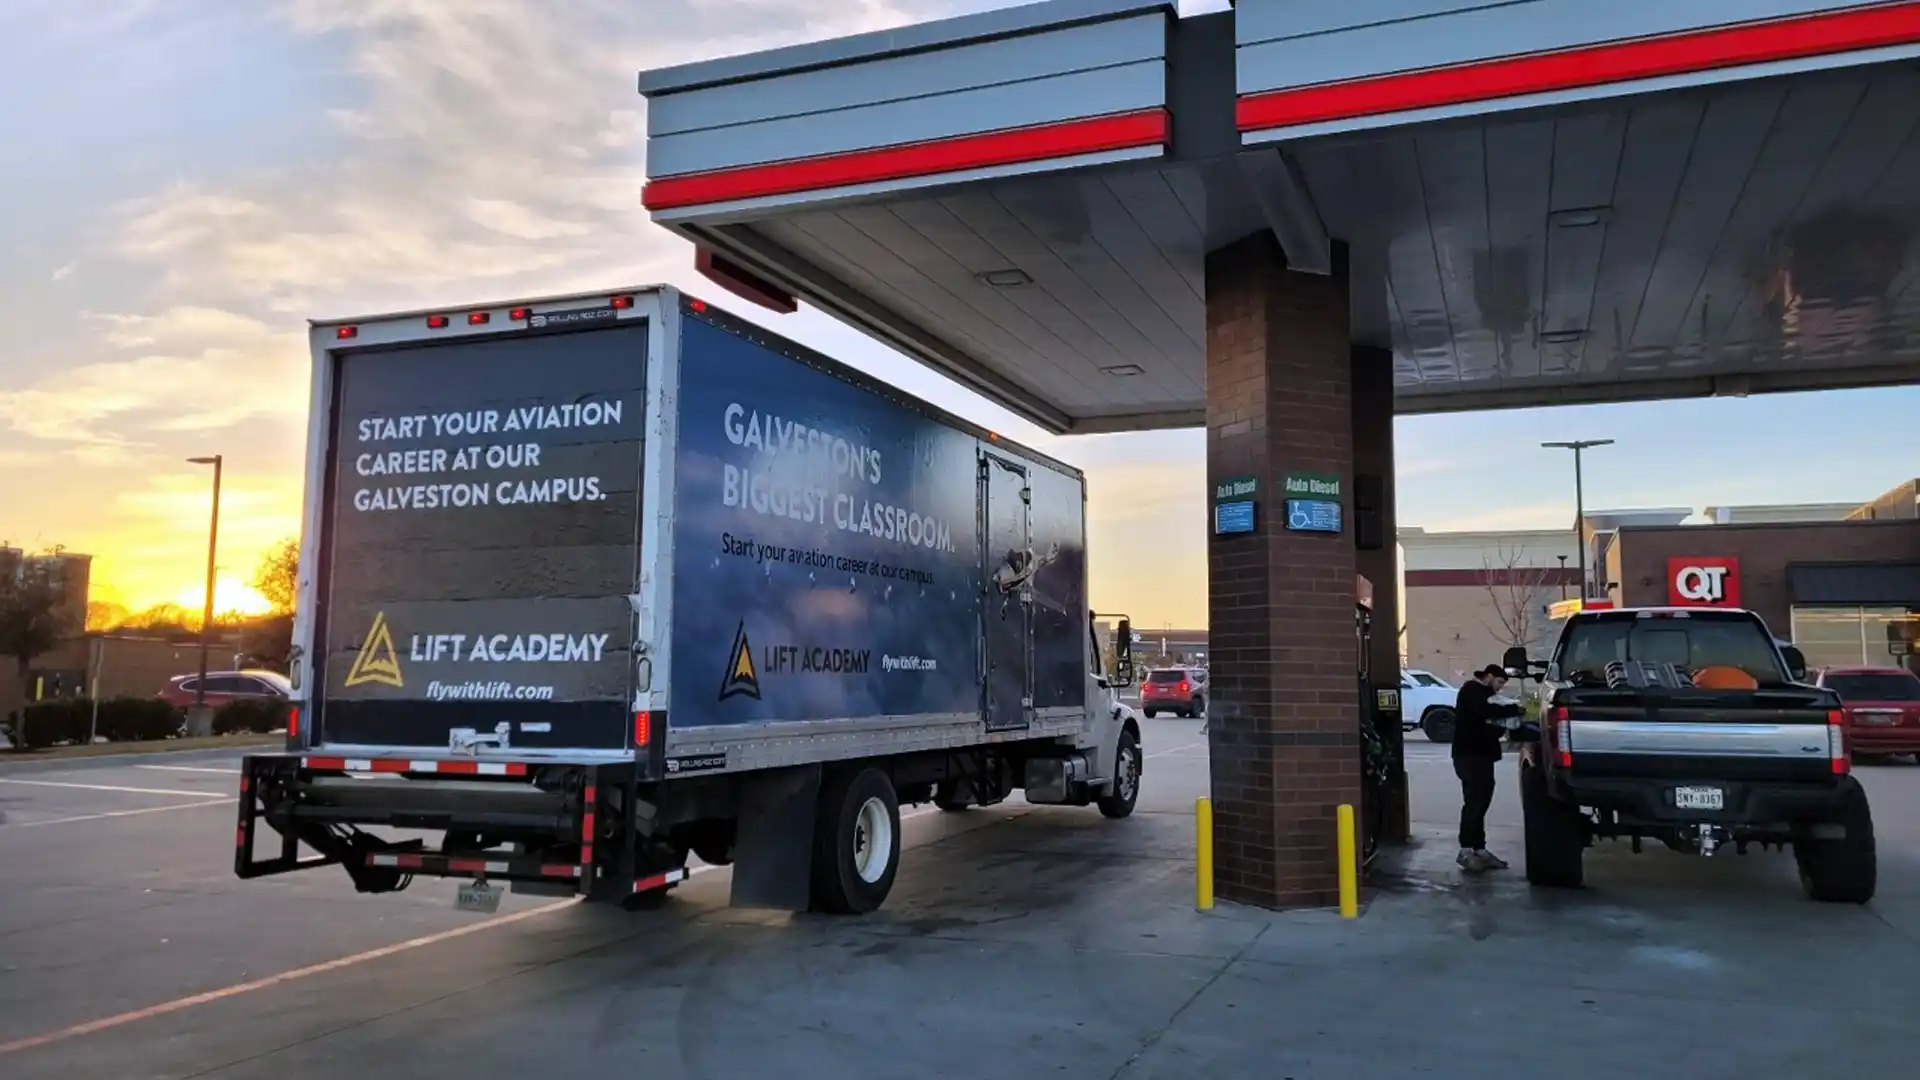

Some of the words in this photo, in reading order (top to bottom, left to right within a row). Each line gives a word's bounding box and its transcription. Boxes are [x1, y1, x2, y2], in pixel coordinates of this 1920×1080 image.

[358, 415, 428, 441] START
[432, 410, 498, 436] YOUR
[503, 400, 622, 432] AVIATION
[355, 448, 447, 476] CAREER
[452, 447, 483, 471] AT
[486, 443, 540, 468] OUR
[724, 403, 881, 485] GALVESTON'S
[354, 482, 489, 511] GALVESTON
[496, 476, 606, 505] CAMPUS.
[1216, 484, 1232, 499] Auto
[1233, 478, 1255, 496] Diesel
[1286, 477, 1308, 492] Auto
[1310, 479, 1340, 495] Diesel
[723, 463, 829, 525] BIGGEST
[833, 493, 956, 553] CLASSROOM.
[722, 532, 754, 558] Start
[757, 543, 786, 564] your
[788, 547, 834, 569] aviation
[835, 555, 867, 574] career
[869, 561, 879, 576] at
[881, 565, 899, 578] our
[1676, 566, 1727, 602] QT
[410, 634, 466, 661] LIFT
[468, 633, 609, 662] ACADEMY
[764, 645, 797, 673] LIFT
[802, 647, 871, 674] ACADEMY
[881, 653, 936, 672] flywithlift.com
[426, 680, 553, 701] flywithlift.com
